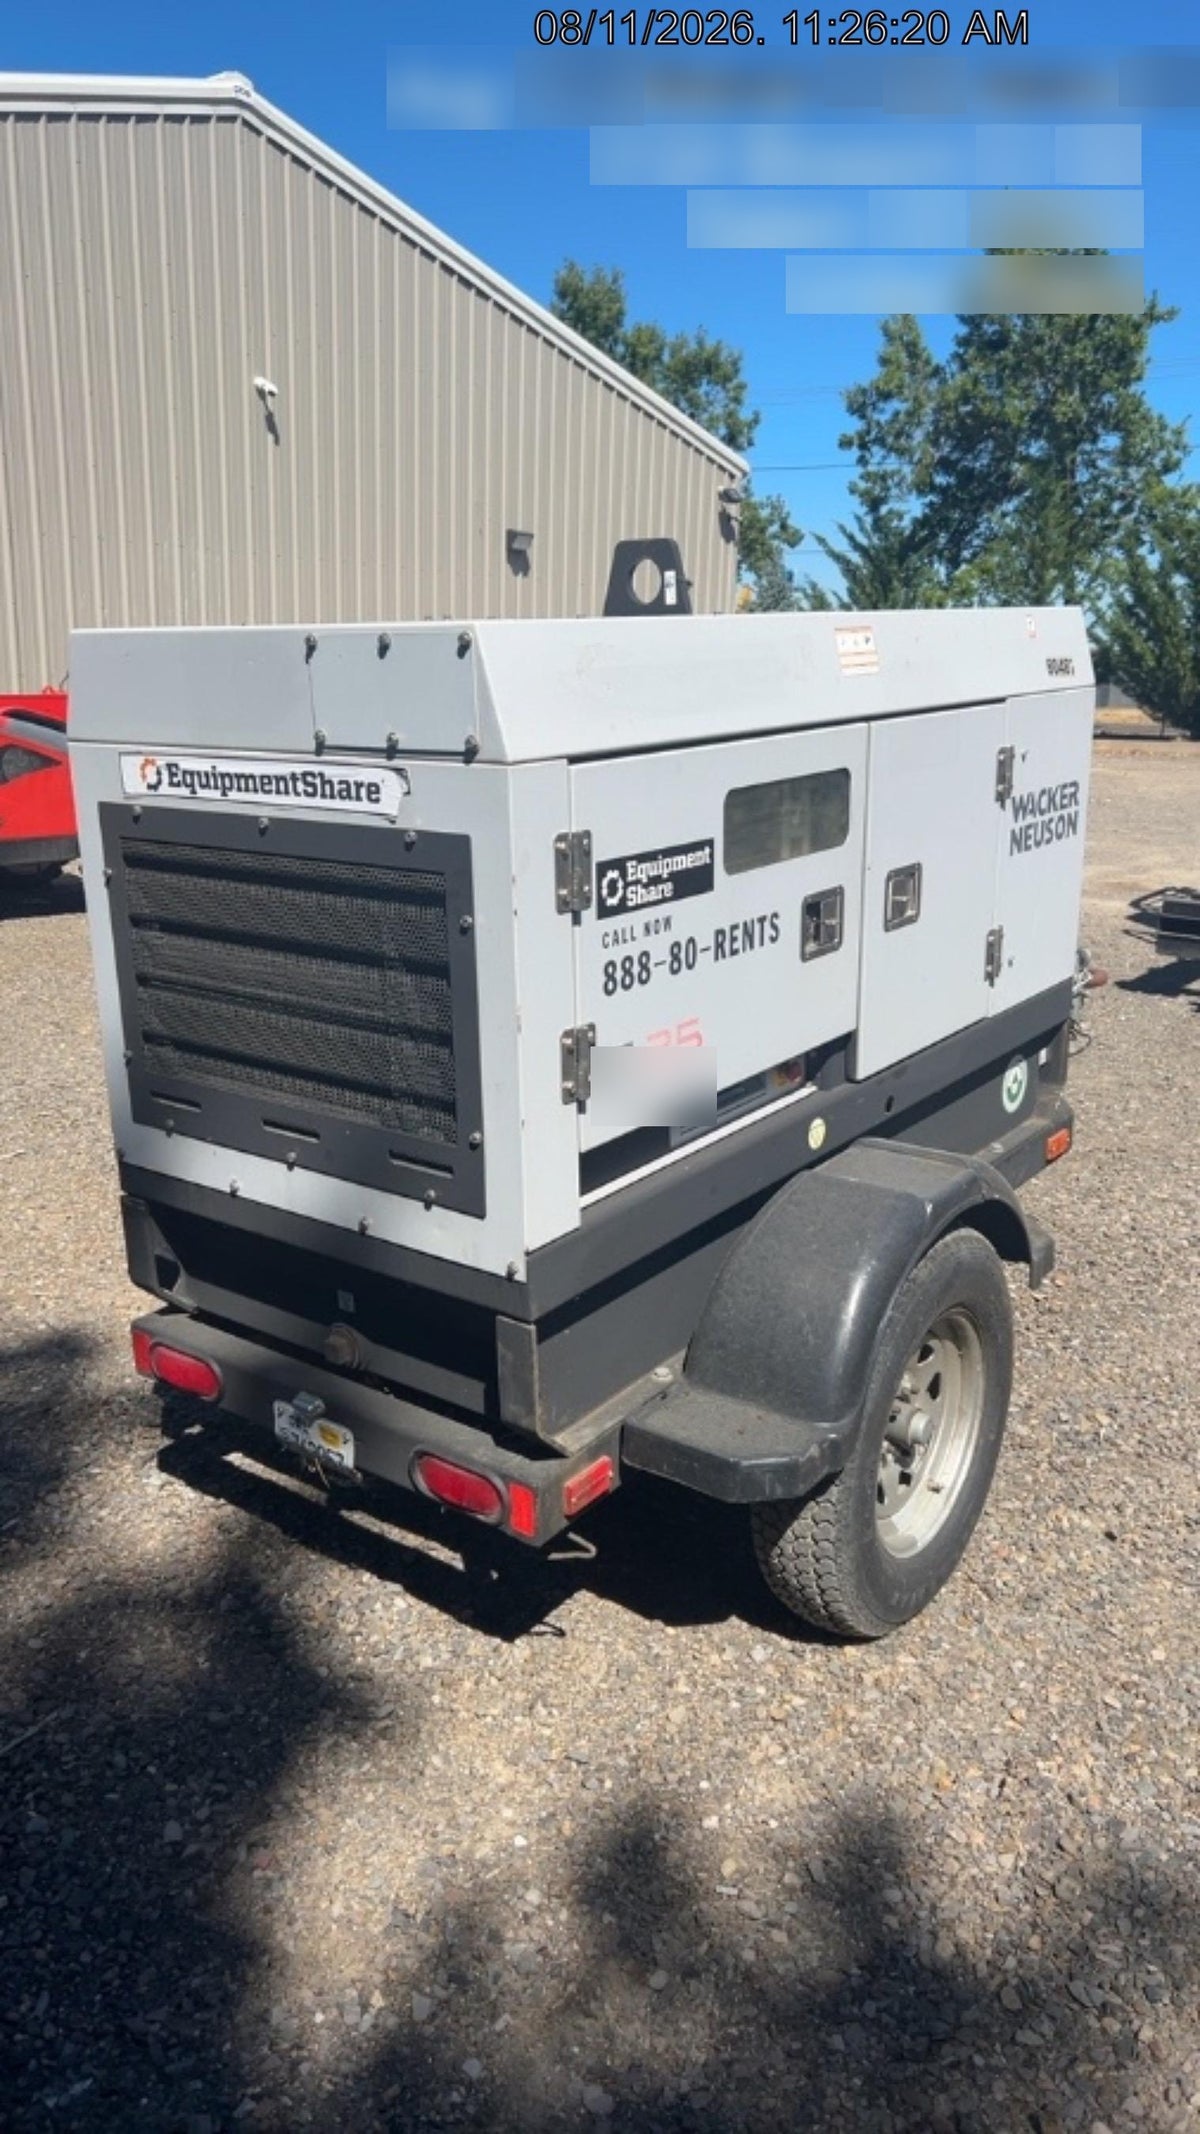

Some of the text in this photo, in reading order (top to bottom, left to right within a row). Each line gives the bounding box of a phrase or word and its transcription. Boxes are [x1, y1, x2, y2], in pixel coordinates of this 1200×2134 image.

[166, 763, 381, 803] EquipmentShare
[1010, 781, 1080, 822] WACKER
[1010, 812, 1079, 856] NEUSON
[626, 846, 711, 882] Equipment
[626, 881, 673, 907] Share
[603, 916, 672, 949] CALL NOW
[603, 912, 780, 997] 888-80-RENTS
